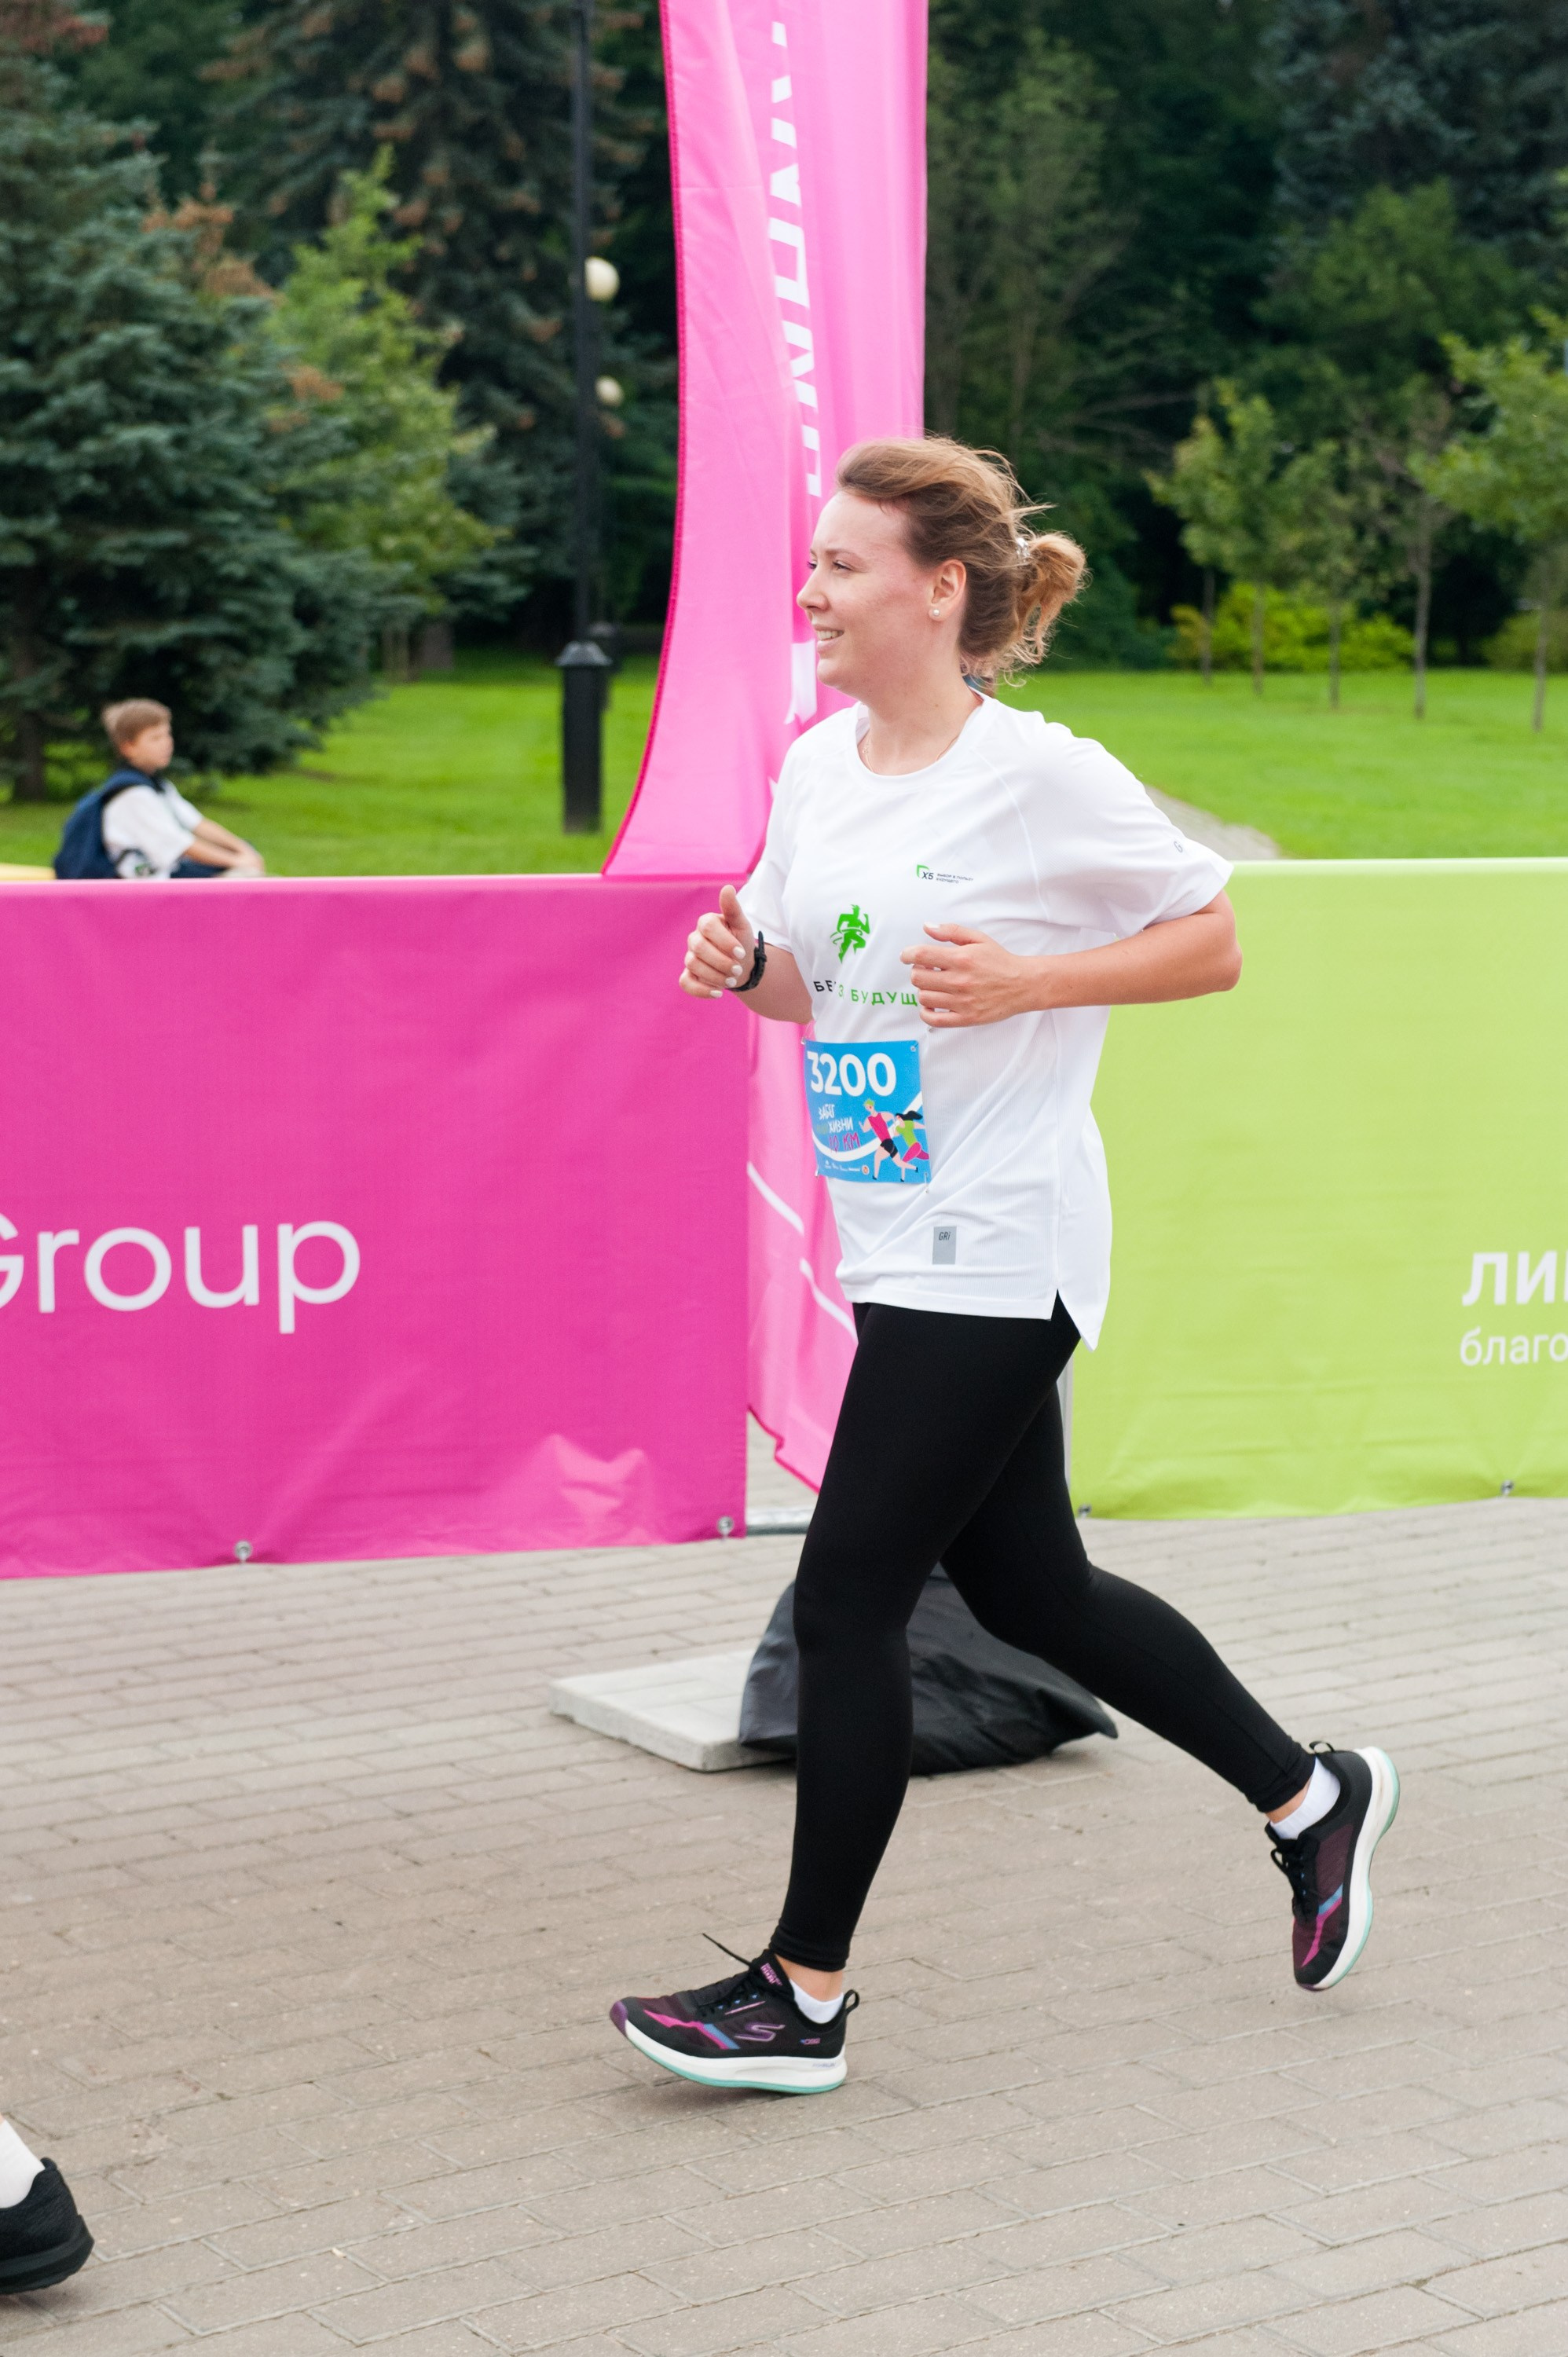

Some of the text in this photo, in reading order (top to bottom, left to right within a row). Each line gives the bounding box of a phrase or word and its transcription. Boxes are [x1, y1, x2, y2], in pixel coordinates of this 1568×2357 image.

[921, 871, 934, 880] X5
[814, 980, 837, 992] БЕ
[807, 1050, 896, 1097] 3200
[0, 1212, 361, 1334] roup
[1461, 1250, 1568, 1307] ЛИ
[1460, 1325, 1568, 1366] благо
